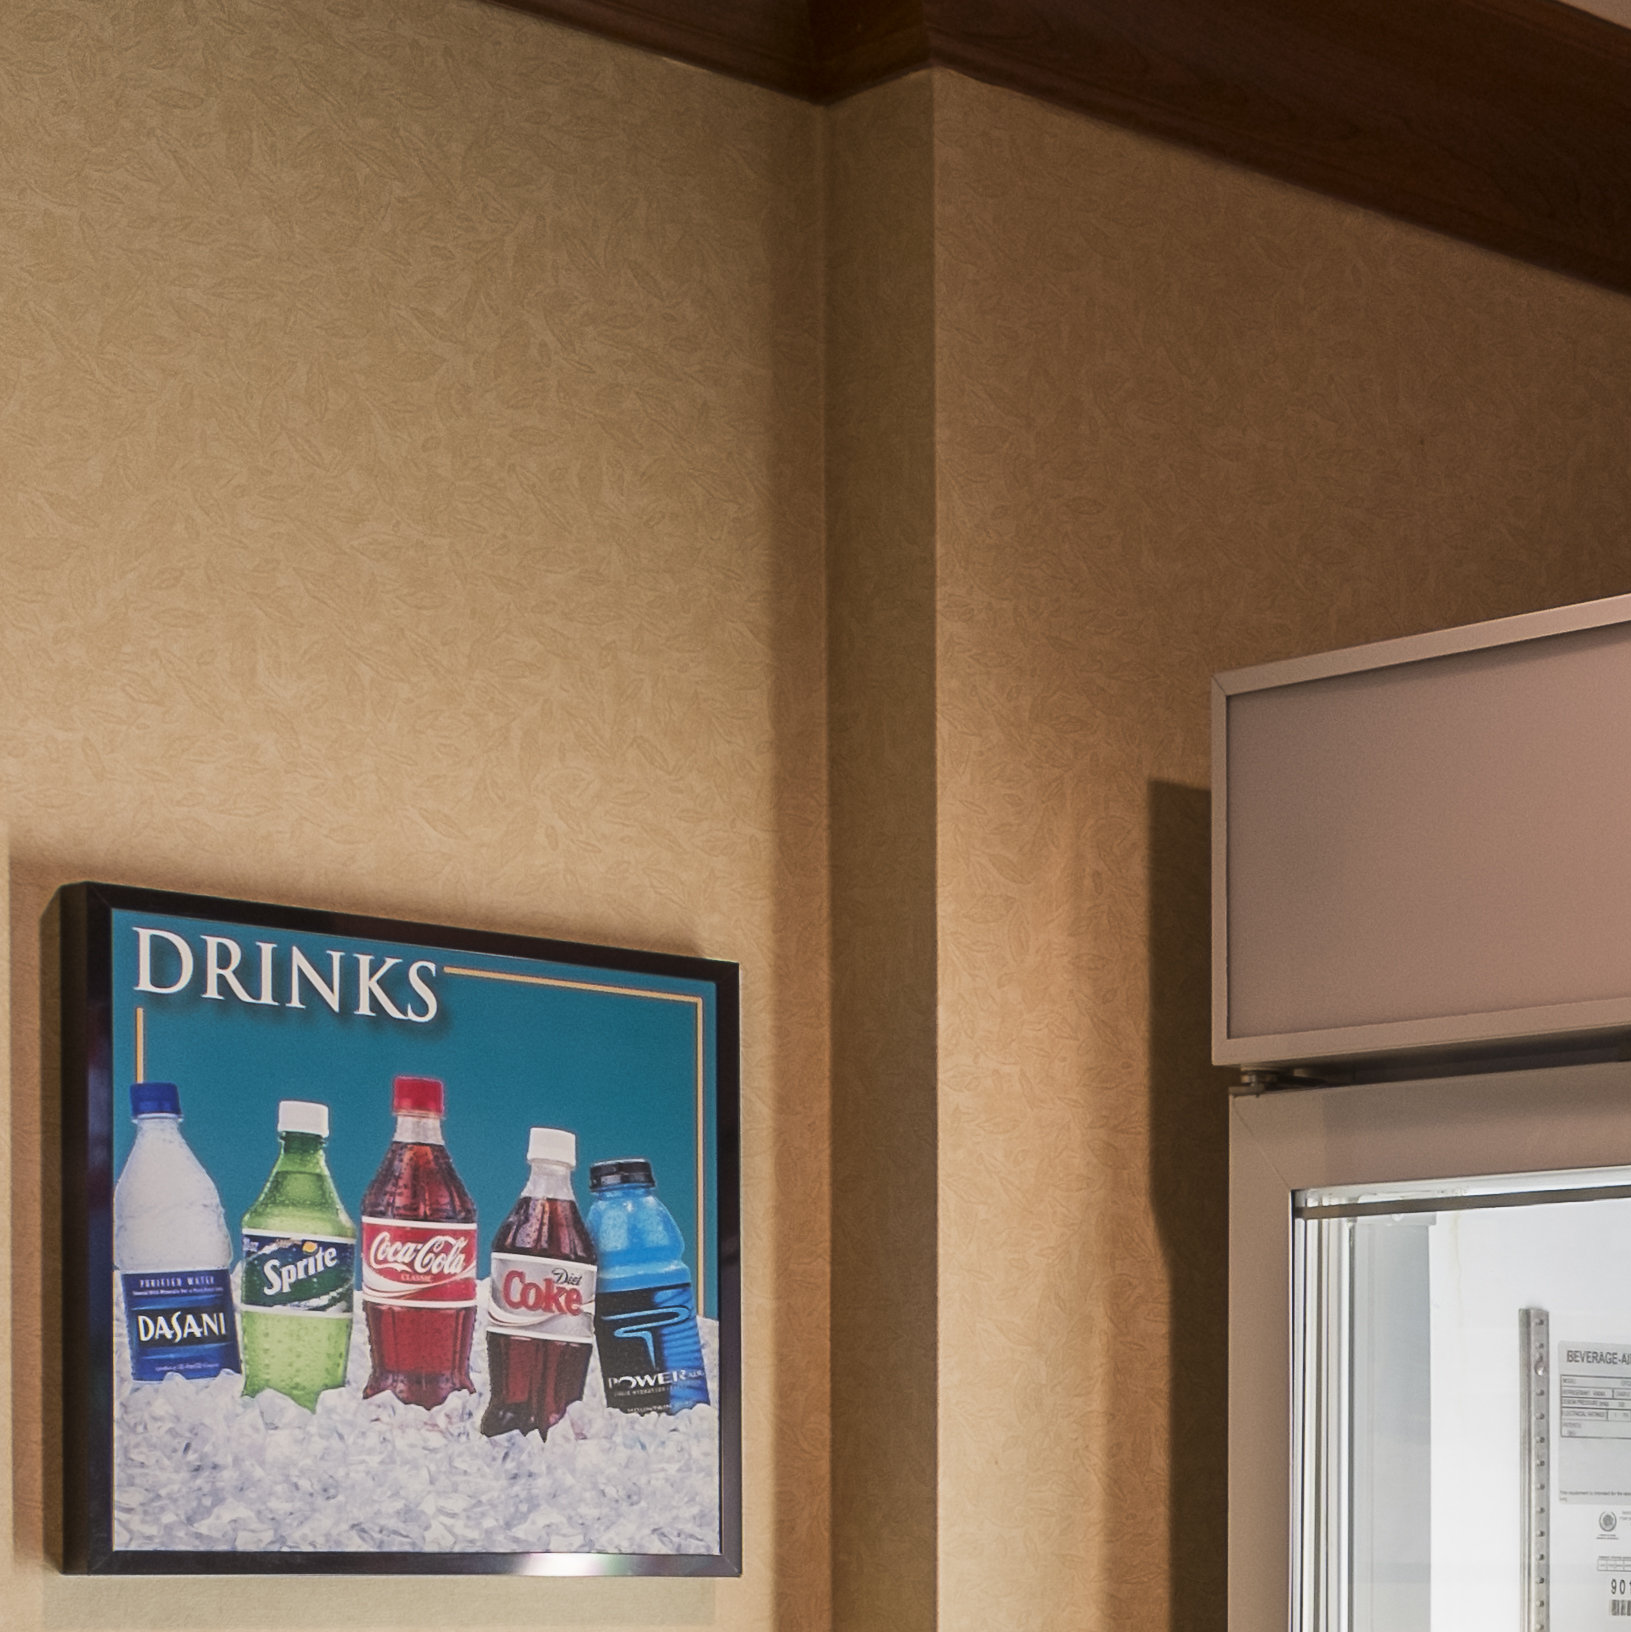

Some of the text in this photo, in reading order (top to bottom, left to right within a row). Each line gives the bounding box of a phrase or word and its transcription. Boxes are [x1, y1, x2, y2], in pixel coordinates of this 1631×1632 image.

[132, 926, 439, 1023] DRINKS
[263, 1246, 338, 1296] Sprite
[370, 1231, 468, 1275] Coca-Cola
[187, 1276, 215, 1286] WATER
[400, 1274, 433, 1283] CLASSIC
[502, 1269, 584, 1316] Coke
[551, 1268, 583, 1286] Diet
[137, 1311, 227, 1343] DASANI
